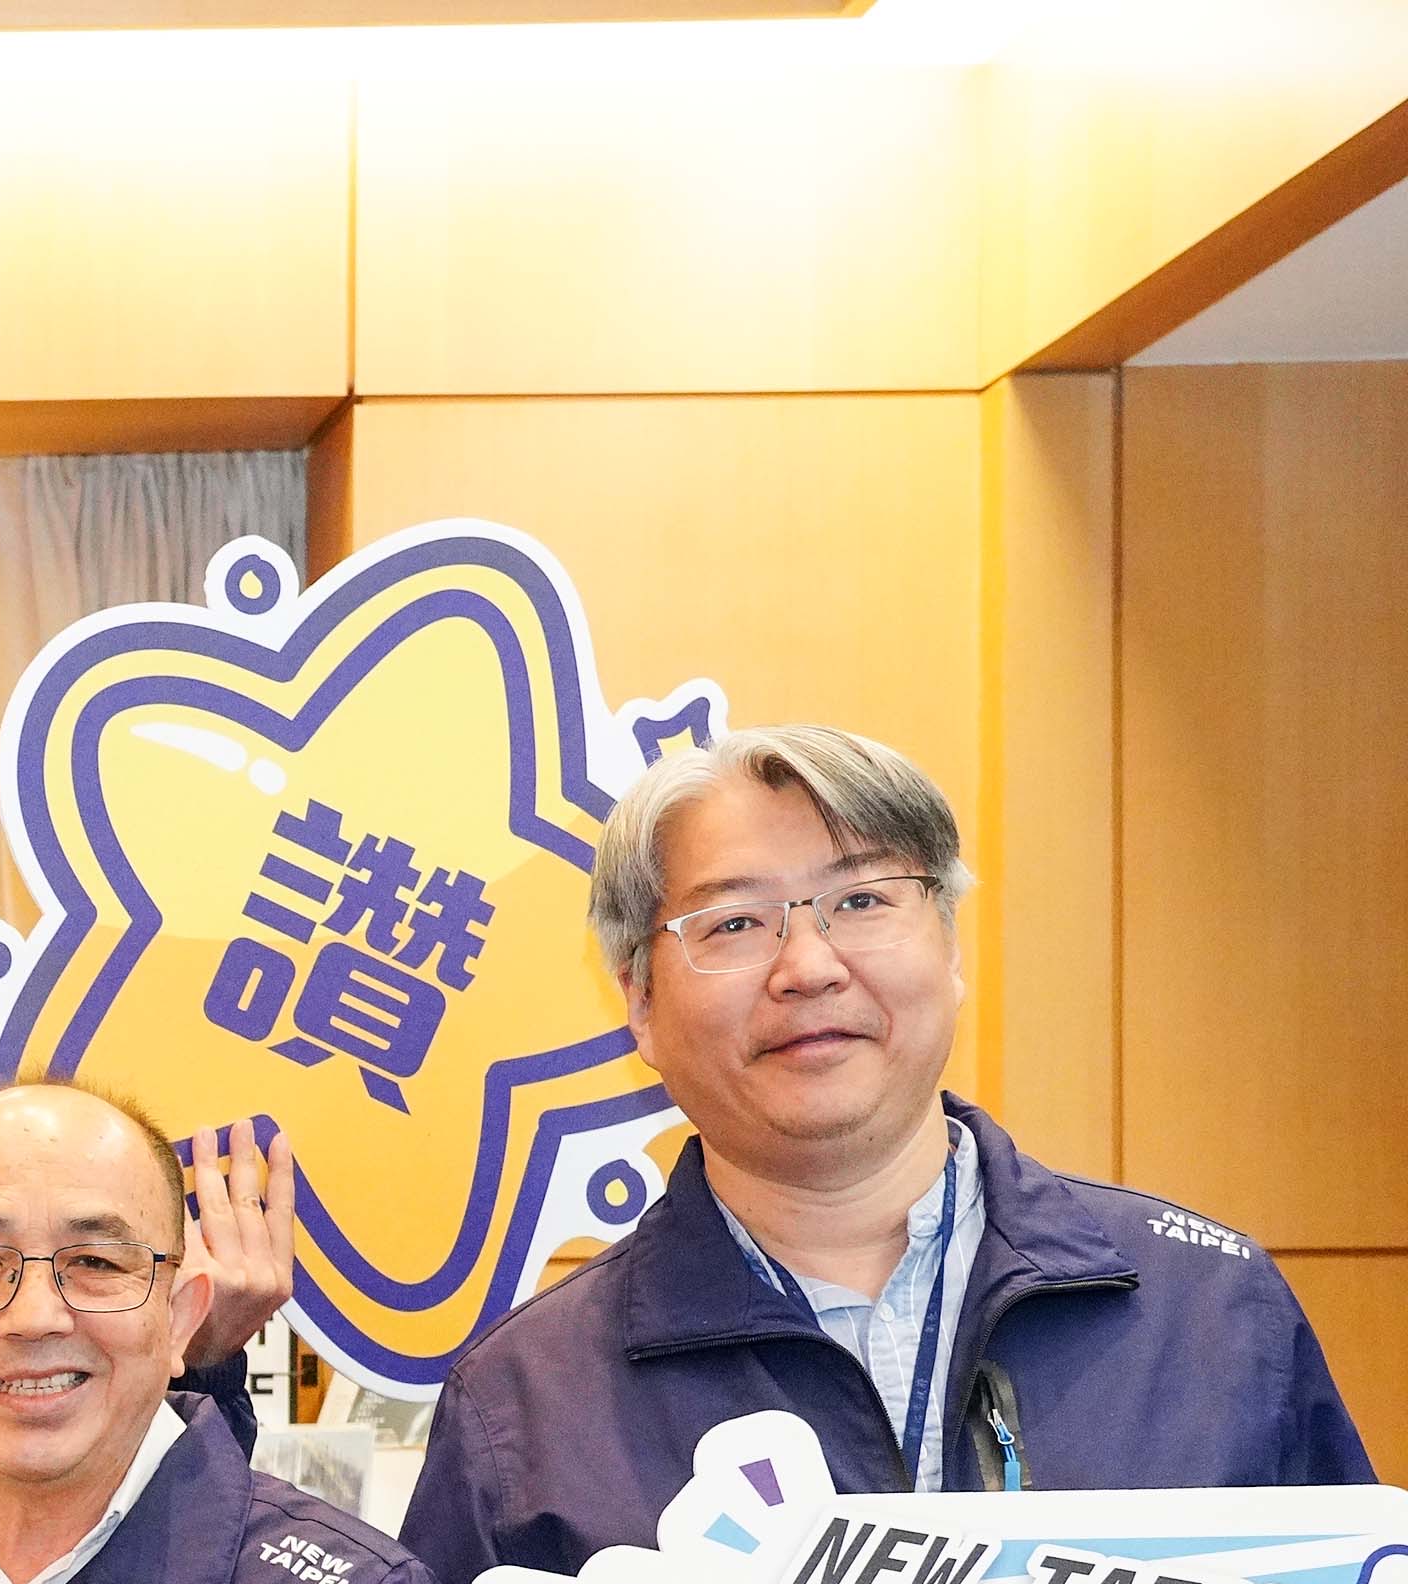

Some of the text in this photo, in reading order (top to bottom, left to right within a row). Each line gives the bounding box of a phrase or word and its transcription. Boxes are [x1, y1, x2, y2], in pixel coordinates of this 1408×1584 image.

[203, 798, 495, 1115] 讚
[1147, 1218, 1251, 1260] TAIPEI
[1162, 1211, 1236, 1242] NEW
[279, 1535, 354, 1575] NEW
